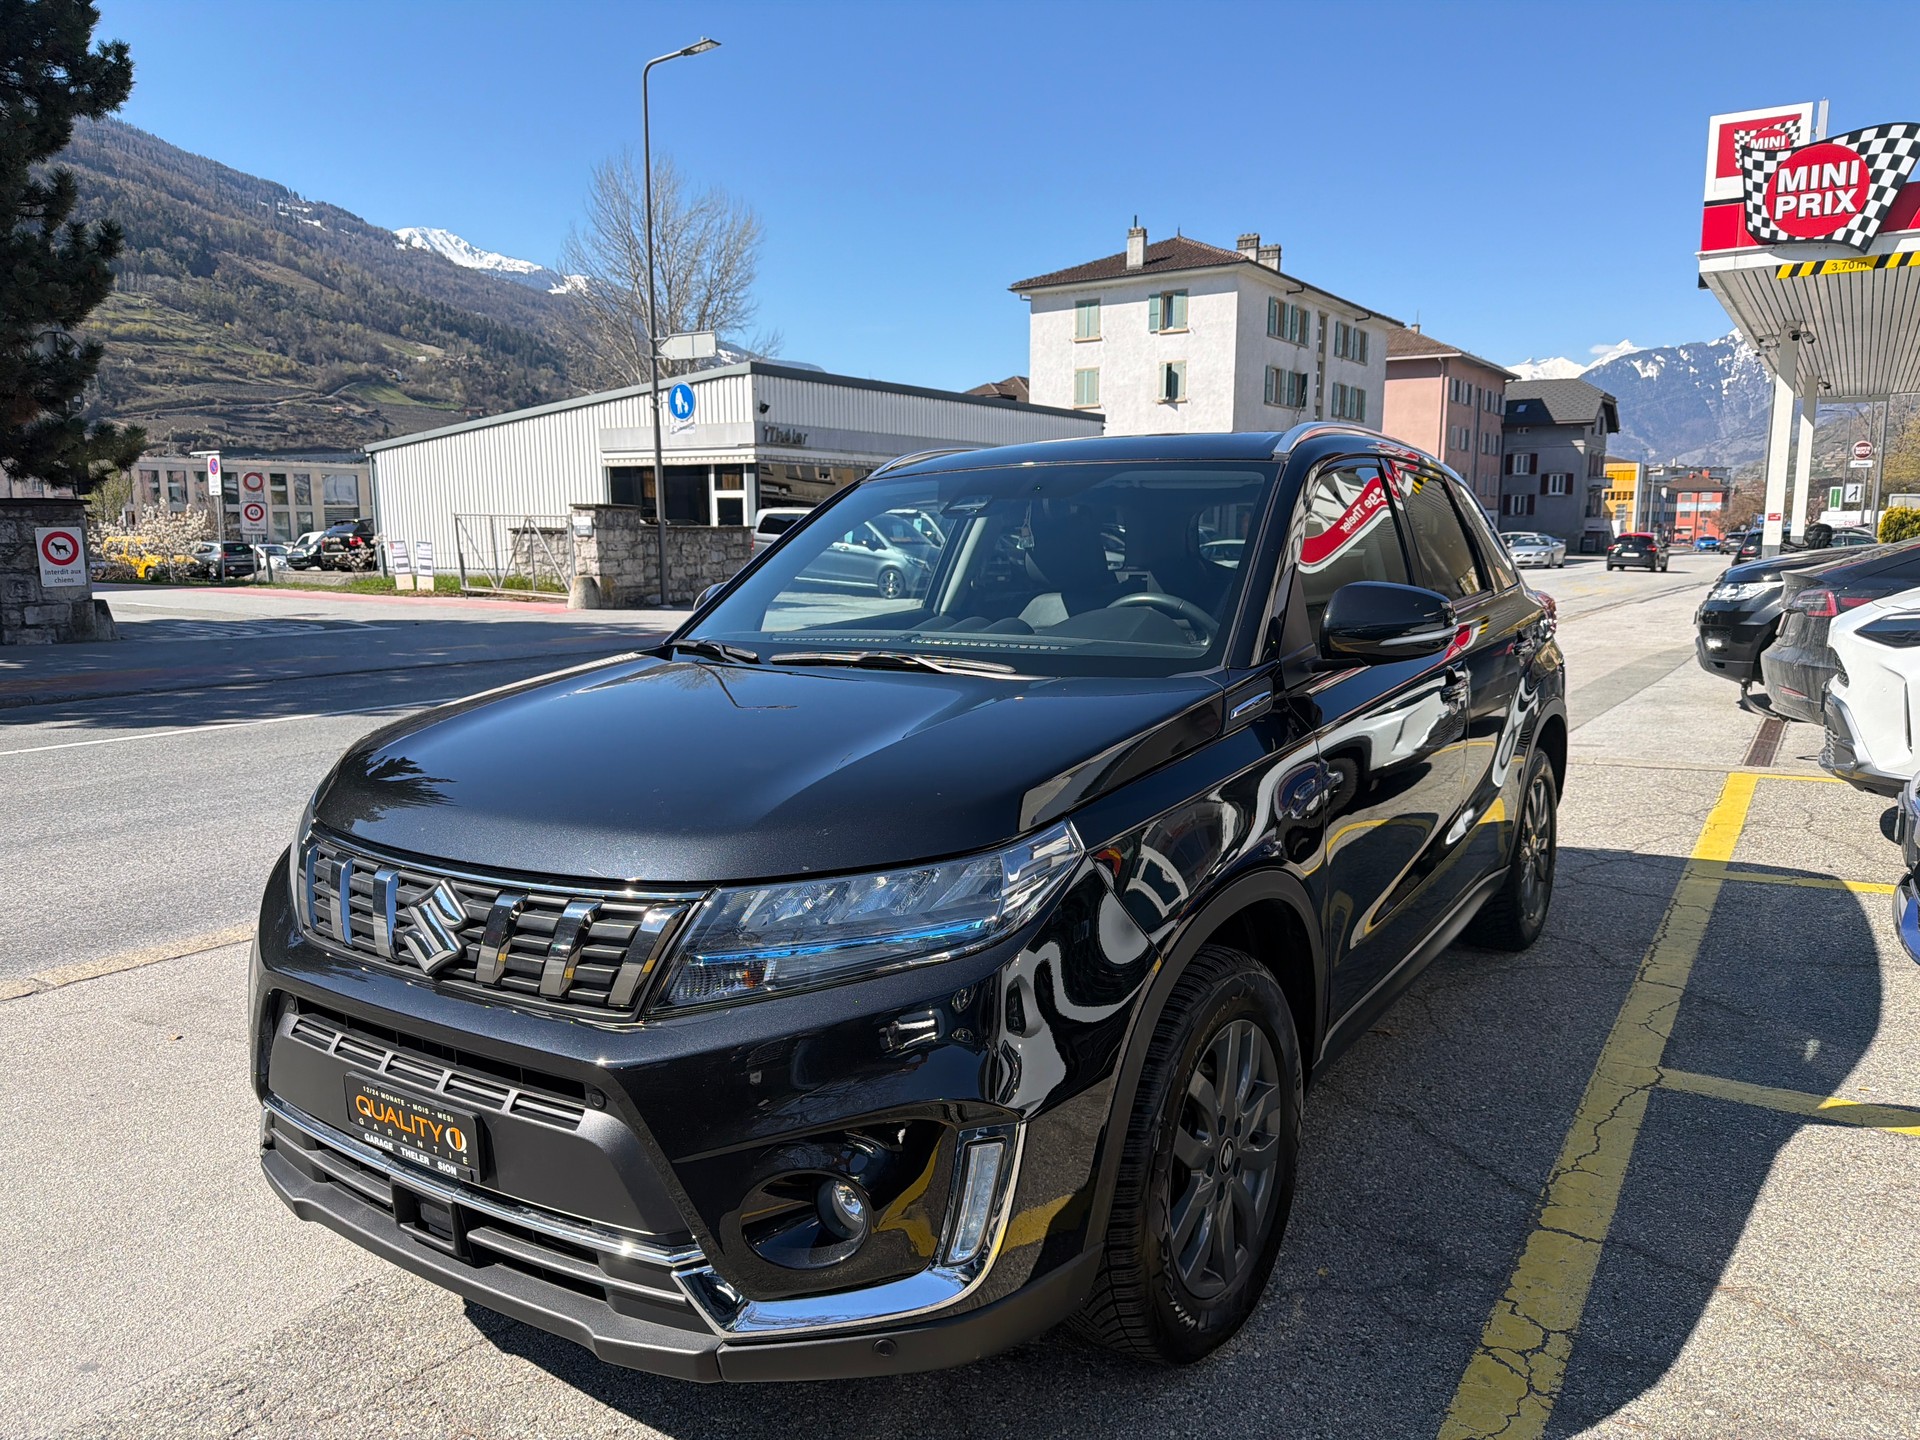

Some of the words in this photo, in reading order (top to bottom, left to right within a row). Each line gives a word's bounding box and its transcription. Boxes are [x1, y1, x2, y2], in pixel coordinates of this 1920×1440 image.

[1749, 135, 1786, 150] MINI
[1776, 159, 1860, 193] MINI
[1774, 188, 1858, 221] PRIX
[249, 509, 259, 517] 40
[44, 568, 69, 576] Interdit
[355, 1095, 443, 1143] QUALITY
[362, 1086, 379, 1097] 12/24
[381, 1092, 405, 1106] MONATE
[412, 1104, 429, 1115] MOIS
[437, 1112, 454, 1123] MESI
[364, 1132, 394, 1152] GARAGE
[400, 1146, 430, 1166] THELER
[437, 1161, 457, 1176] SION
